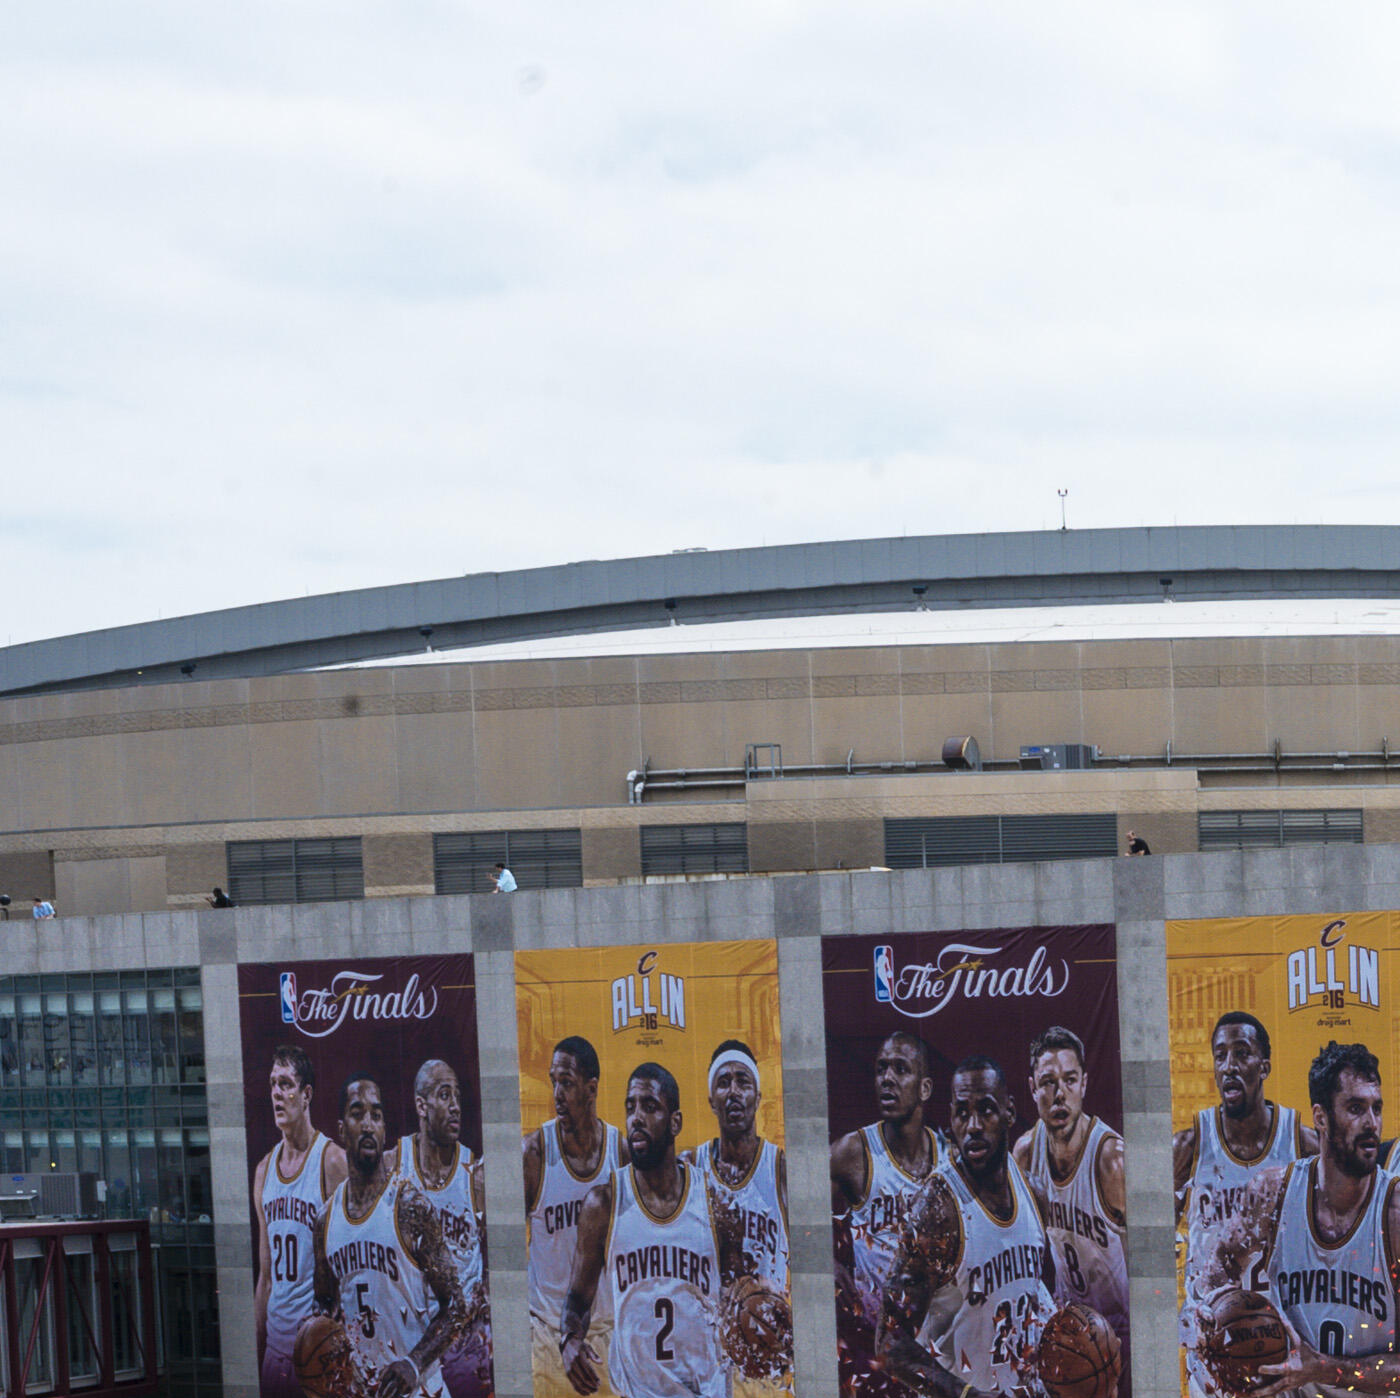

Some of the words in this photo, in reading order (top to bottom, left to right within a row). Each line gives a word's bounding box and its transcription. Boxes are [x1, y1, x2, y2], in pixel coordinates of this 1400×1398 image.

[611, 973, 658, 1031] ALL
[660, 972, 686, 1029] IN
[891, 943, 1069, 1018] Finals
[895, 962, 945, 1000] The
[1287, 946, 1345, 1010] ALL
[1348, 944, 1380, 1008] IN
[294, 971, 438, 1038] Finals
[298, 988, 338, 1022] The
[273, 1233, 298, 1282] 20
[616, 1245, 710, 1296] CAVALIERS
[1063, 1242, 1088, 1294] 8
[355, 1283, 375, 1339] 5
[1278, 1269, 1387, 1322] CAVALIERS
[654, 1297, 675, 1361] 2
